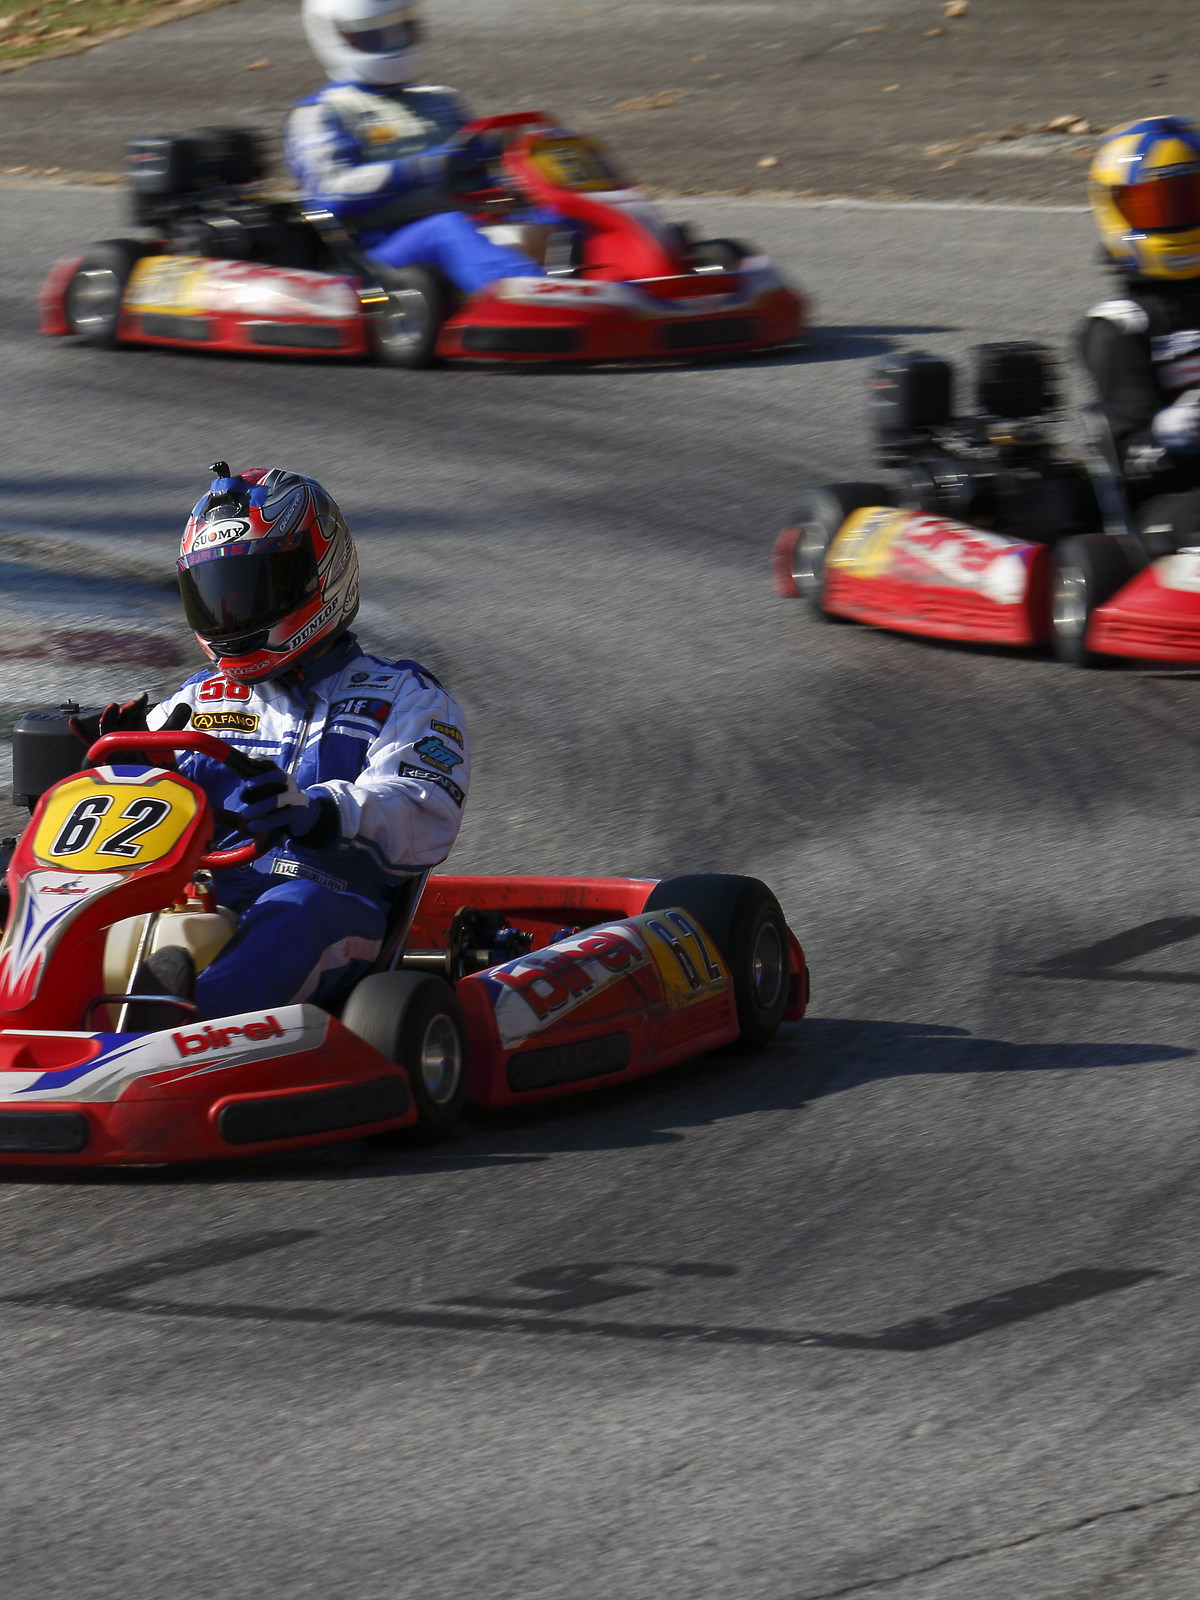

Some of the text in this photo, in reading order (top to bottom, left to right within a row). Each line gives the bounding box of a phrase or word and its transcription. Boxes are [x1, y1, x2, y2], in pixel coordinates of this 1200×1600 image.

[195, 527, 243, 548] SUOMY
[291, 597, 339, 649] DUNLOP
[194, 714, 255, 728] ALFANO
[330, 699, 368, 717] elf
[402, 766, 461, 800] RECARO
[50, 795, 171, 858] 62
[40, 885, 90, 894] birel
[644, 910, 724, 990] 62
[491, 930, 643, 1021] birel
[172, 1015, 284, 1058] birel
